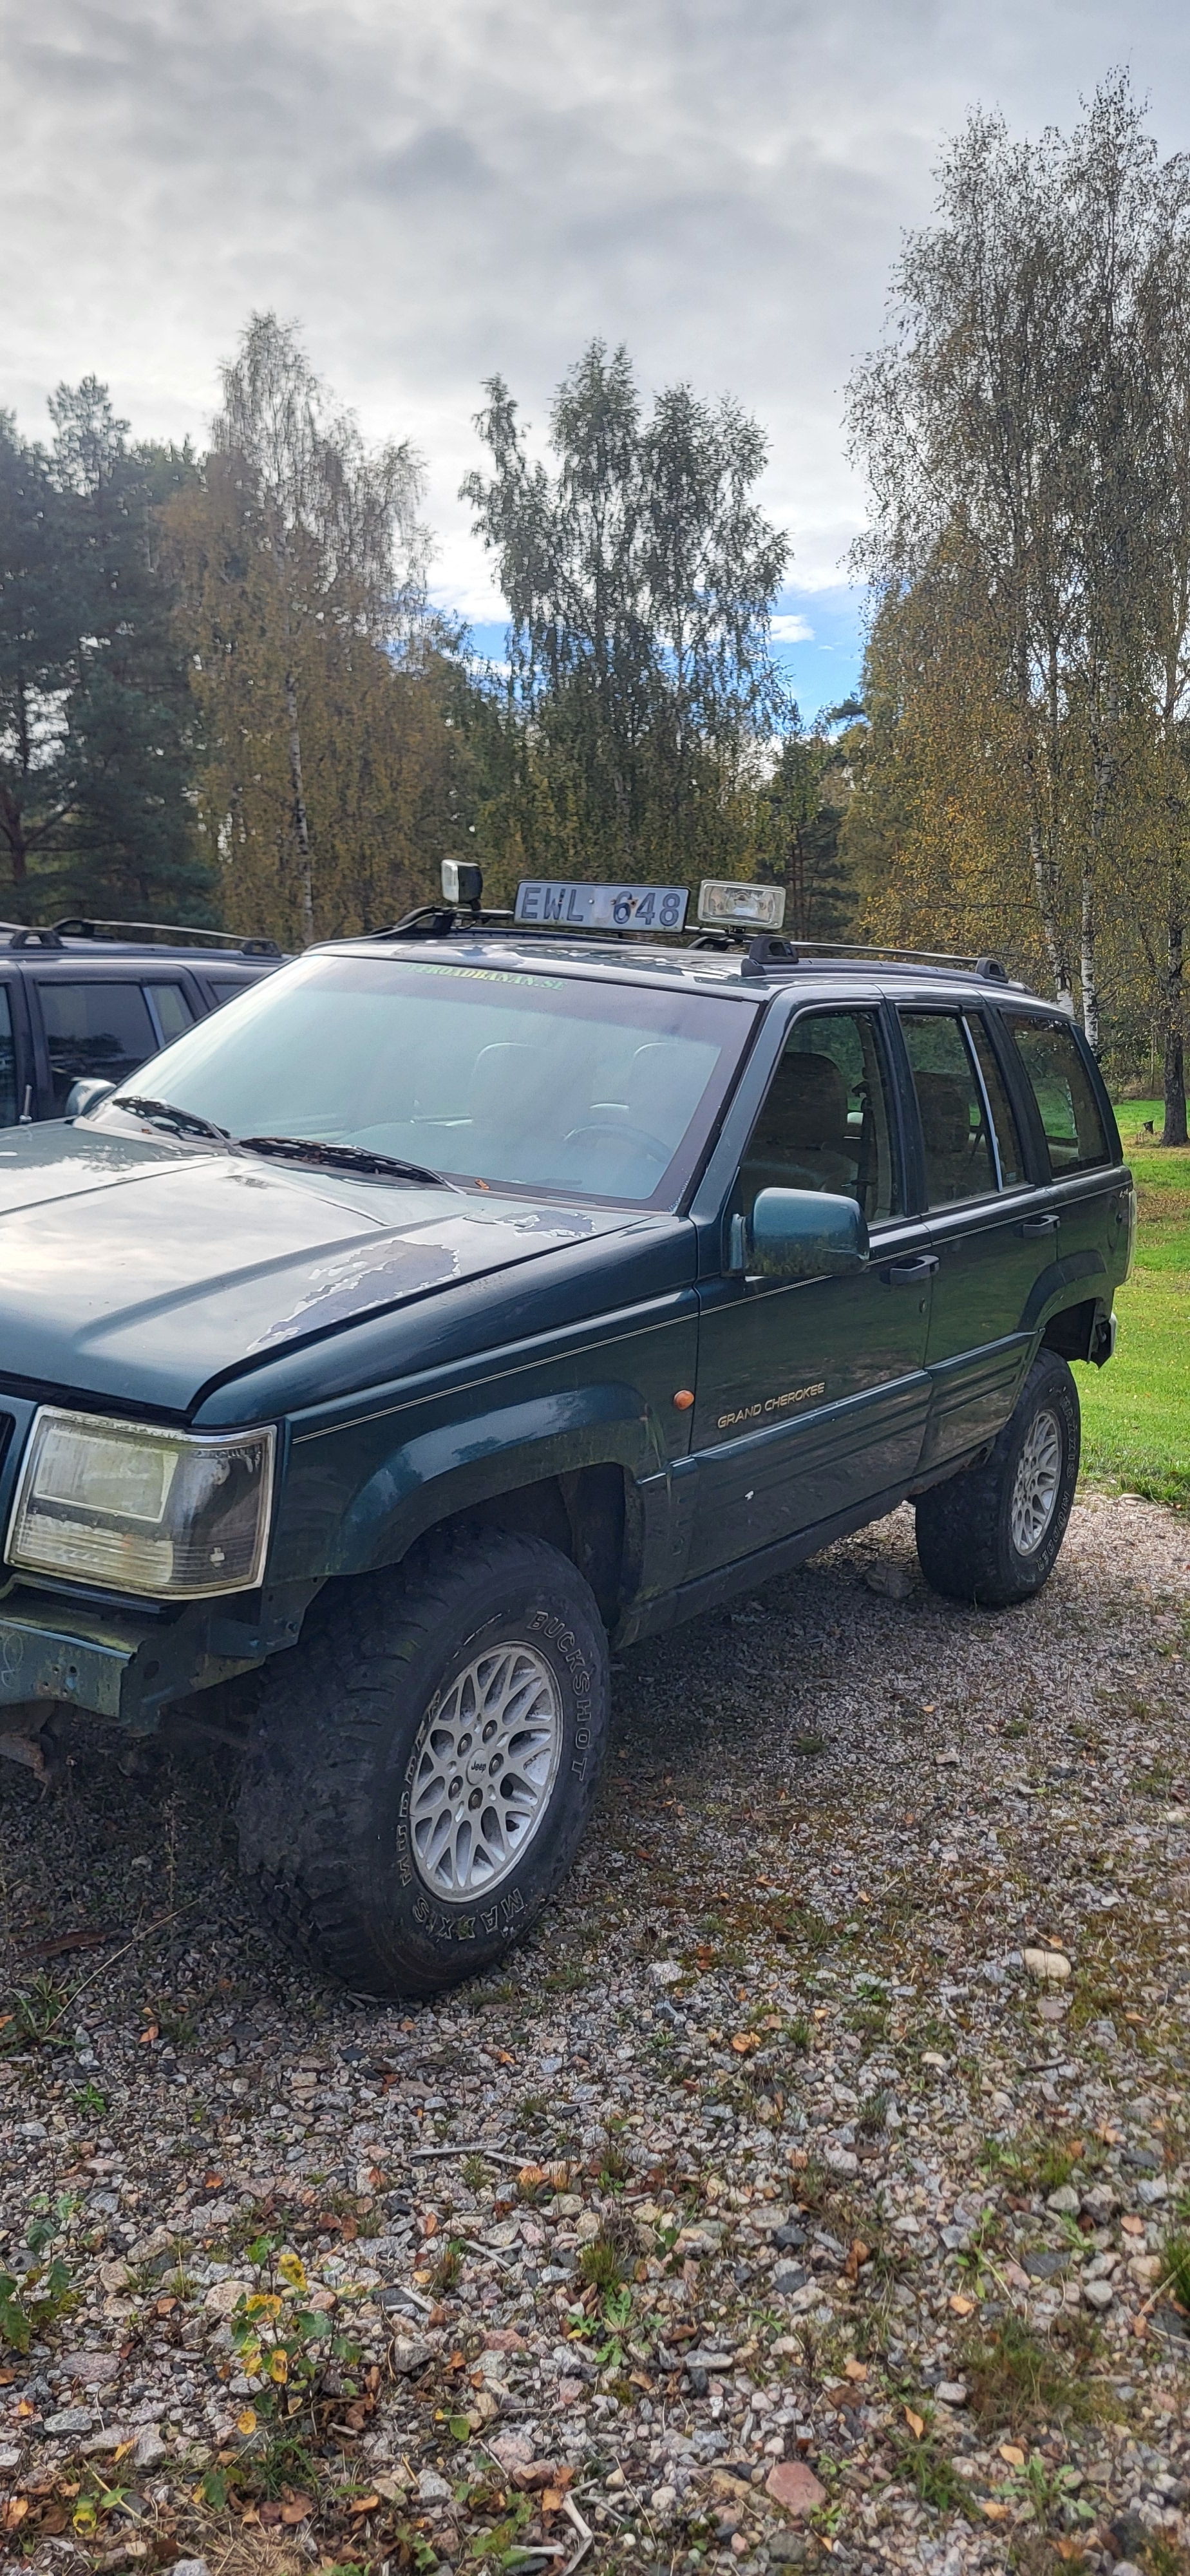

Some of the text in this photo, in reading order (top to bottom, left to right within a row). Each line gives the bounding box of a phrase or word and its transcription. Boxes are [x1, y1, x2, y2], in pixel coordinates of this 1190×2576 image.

[520, 887, 681, 927] EWL 648
[717, 1382, 826, 1429] GRAND CHEROKEE
[527, 1610, 591, 1782] BUCKSHOT
[471, 1760, 487, 1774] Jeep
[412, 1888, 525, 1941] MAXXIS
